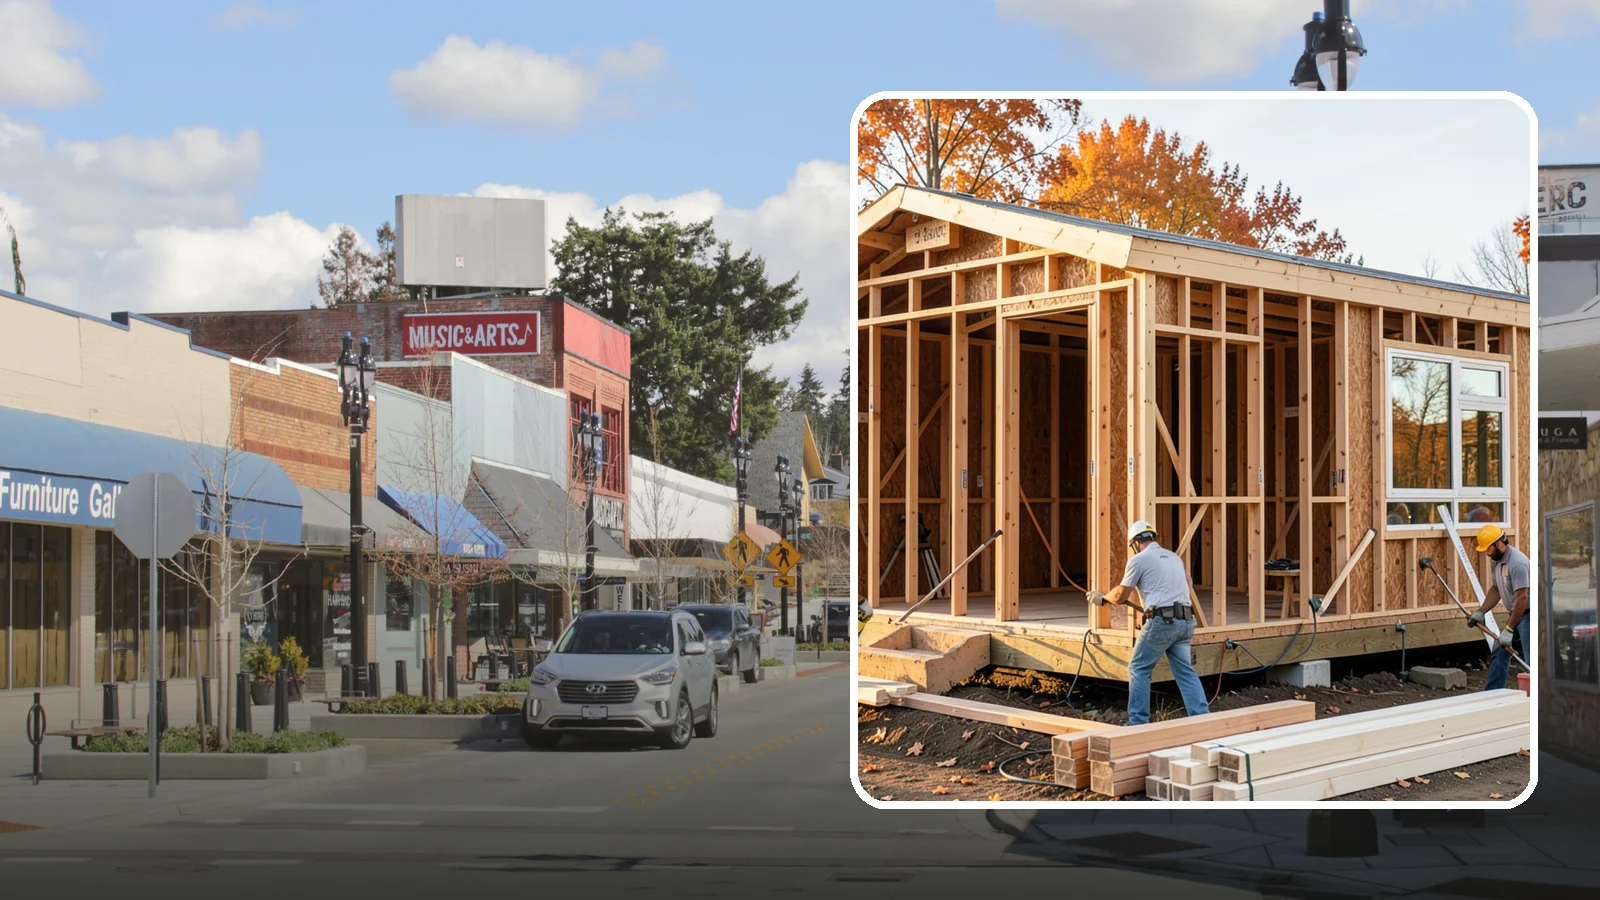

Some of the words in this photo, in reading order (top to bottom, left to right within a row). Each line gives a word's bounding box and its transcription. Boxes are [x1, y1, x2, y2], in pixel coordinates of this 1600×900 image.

[409, 323, 519, 348] MUSIC&ARTS
[0, 472, 79, 515] Furniture
[89, 482, 122, 518] Gal
